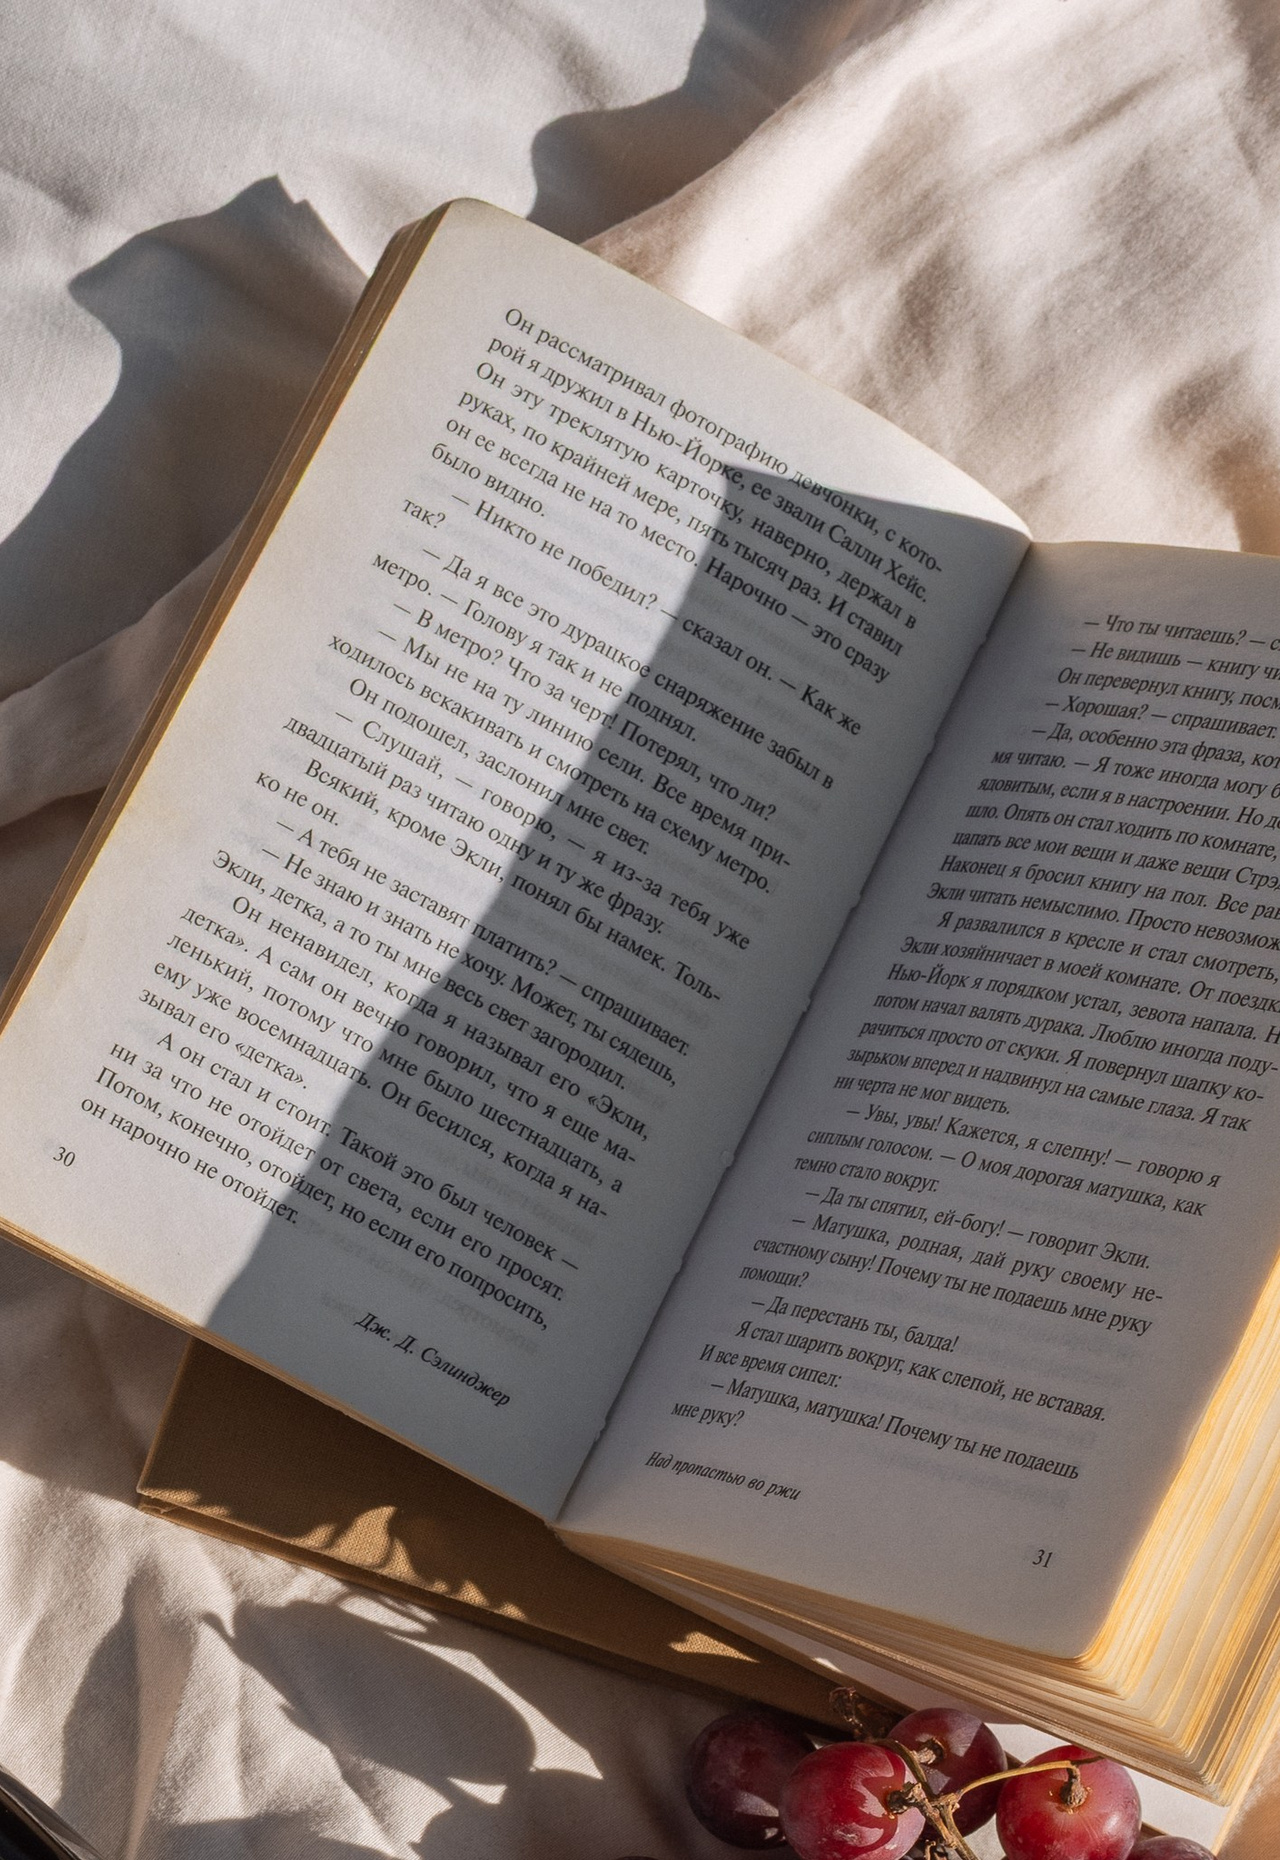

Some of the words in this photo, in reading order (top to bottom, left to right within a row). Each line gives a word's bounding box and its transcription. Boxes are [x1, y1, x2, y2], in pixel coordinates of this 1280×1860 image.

[431, 442, 482, 480] было
[483, 474, 545, 518] видно.
[486, 337, 527, 366] рой
[526, 358, 542, 374] я
[539, 366, 615, 414] дружил
[615, 406, 629, 421] в
[630, 410, 745, 491] Нью-Йорке,
[750, 482, 773, 501] ее
[773, 494, 827, 534] звали
[828, 524, 884, 571] Салли
[882, 558, 927, 603] Хейс.
[504, 308, 535, 336] Он
[534, 328, 667, 407] рассматривал
[669, 399, 789, 475] фотографию
[787, 470, 879, 536] девчонки,
[884, 528, 897, 543] с
[897, 536, 942, 572] кото-
[402, 499, 447, 529] так?
[457, 391, 516, 434] руках,
[521, 425, 548, 447] по
[549, 440, 631, 493] крайней
[632, 485, 681, 525] мере,
[686, 515, 730, 548] пять
[733, 540, 789, 583] тысяч
[786, 575, 822, 605] раз.
[826, 593, 848, 618] И
[846, 611, 904, 657] ставил
[476, 361, 507, 389] Он
[511, 384, 545, 411] эту
[548, 403, 650, 467] треклятую
[655, 463, 745, 525] карточку,
[750, 516, 831, 577] наверно,
[835, 570, 903, 620] держал
[904, 614, 917, 630] в
[349, 678, 380, 706] Он
[380, 698, 469, 759] подошел,
[475, 750, 565, 807] заслонил
[565, 799, 605, 829] мне
[607, 823, 650, 856] свет.
[964, 805, 999, 819] шло.
[1003, 803, 1051, 824] Опять
[1053, 813, 1077, 827] он
[1077, 816, 1115, 833] стал
[1114, 821, 1173, 842] ходить
[1174, 830, 1200, 846] по
[1200, 834, 1278, 862] комнате,
[304, 758, 380, 815] Всякий,
[386, 807, 447, 847] кроме
[450, 837, 504, 883] Экли,
[510, 874, 572, 916] понял
[574, 906, 604, 934] бы
[605, 926, 665, 972] намек.
[674, 960, 721, 1001] Толь-
[936, 911, 954, 928] Я
[952, 917, 1046, 940] развалился
[1048, 929, 1062, 942] в
[1064, 932, 1125, 954] кресле
[1128, 943, 1144, 957] и
[1147, 946, 1189, 965] стал
[1192, 954, 1279, 985] смотреть,
[232, 895, 263, 924] Он
[267, 918, 374, 988] ненавидел,
[383, 980, 439, 1019] когда
[442, 1013, 459, 1029] я
[462, 1023, 545, 1077] называл
[548, 1072, 581, 1097] его
[587, 1094, 648, 1142] «Экли,
[872, 994, 921, 1011] потом
[920, 999, 967, 1017] начал
[967, 1005, 1022, 1026] валять
[1022, 1015, 1085, 1038] дурака.
[1088, 1022, 1158, 1052] Люблю
[1159, 1040, 1225, 1065] иногда
[1226, 1054, 1279, 1077] поду-
[153, 962, 192, 991] ему
[191, 982, 232, 1011] уже
[235, 1005, 372, 1090] восемнадцать.
[380, 1080, 412, 1110] Он
[415, 1099, 495, 1160] бесился,
[501, 1150, 556, 1190] когда
[558, 1184, 574, 1200] я
[575, 1193, 608, 1217] на-
[833, 1076, 856, 1090] ни
[857, 1078, 897, 1096] черта
[897, 1083, 919, 1098] не
[919, 1087, 953, 1103] мог
[951, 1092, 1010, 1115] видеть.
[846, 1049, 911, 1068] зырьком
[910, 1056, 966, 1078] вперед
[966, 1064, 981, 1079] и
[980, 1067, 1063, 1095] надвинул
[1062, 1083, 1087, 1099] на
[1088, 1088, 1146, 1111] самые
[1146, 1100, 1195, 1122] глаза.
[1198, 1107, 1220, 1125] Я
[1219, 1114, 1252, 1132] так
[857, 1022, 927, 1041] рачиться
[926, 1029, 984, 1049] просто
[985, 1038, 1007, 1053] от
[1007, 1042, 1060, 1064] скуки.
[1063, 1049, 1085, 1067] Я
[1082, 1056, 1169, 1086] повернул
[1169, 1074, 1233, 1100] шапку
[1232, 1086, 1264, 1102] ко-
[52, 1145, 76, 1168] 30
[80, 1098, 108, 1120] он
[108, 1112, 191, 1165] нарочно
[193, 1158, 219, 1180] не
[221, 1174, 299, 1225] отойдет.
[794, 1157, 838, 1174] темно
[839, 1163, 882, 1182] стало
[882, 1170, 940, 1194] вокруг.
[752, 1239, 830, 1265] счастному
[829, 1251, 878, 1273] сыну!
[875, 1255, 943, 1289] Почему
[943, 1275, 968, 1292] ты
[967, 1281, 992, 1297] не
[992, 1286, 1068, 1315] подаешь
[1070, 1304, 1108, 1324] мне
[1105, 1313, 1153, 1337] руку
[352, 1312, 391, 1342] Дж.
[392, 1334, 418, 1355] Д.
[420, 1347, 511, 1408] Сэлинджер
[699, 1343, 717, 1362] И
[714, 1350, 740, 1366] все
[739, 1355, 788, 1376] время
[787, 1365, 843, 1388] сипел:
[734, 1320, 753, 1338] Я
[750, 1327, 785, 1344] стал
[784, 1333, 844, 1358] шарить
[845, 1347, 906, 1376] вокруг,
[907, 1362, 942, 1381] как
[941, 1370, 1006, 1401] слепой,
[1010, 1387, 1035, 1404] не
[1035, 1393, 1105, 1422] вставая.
[670, 1402, 700, 1419] мне
[697, 1408, 746, 1429] руку?
[644, 1451, 674, 1469] Над
[671, 1460, 747, 1486] пропастью
[746, 1478, 766, 1491] во
[762, 1482, 802, 1501] ржи
[1031, 1548, 1053, 1568] 31
